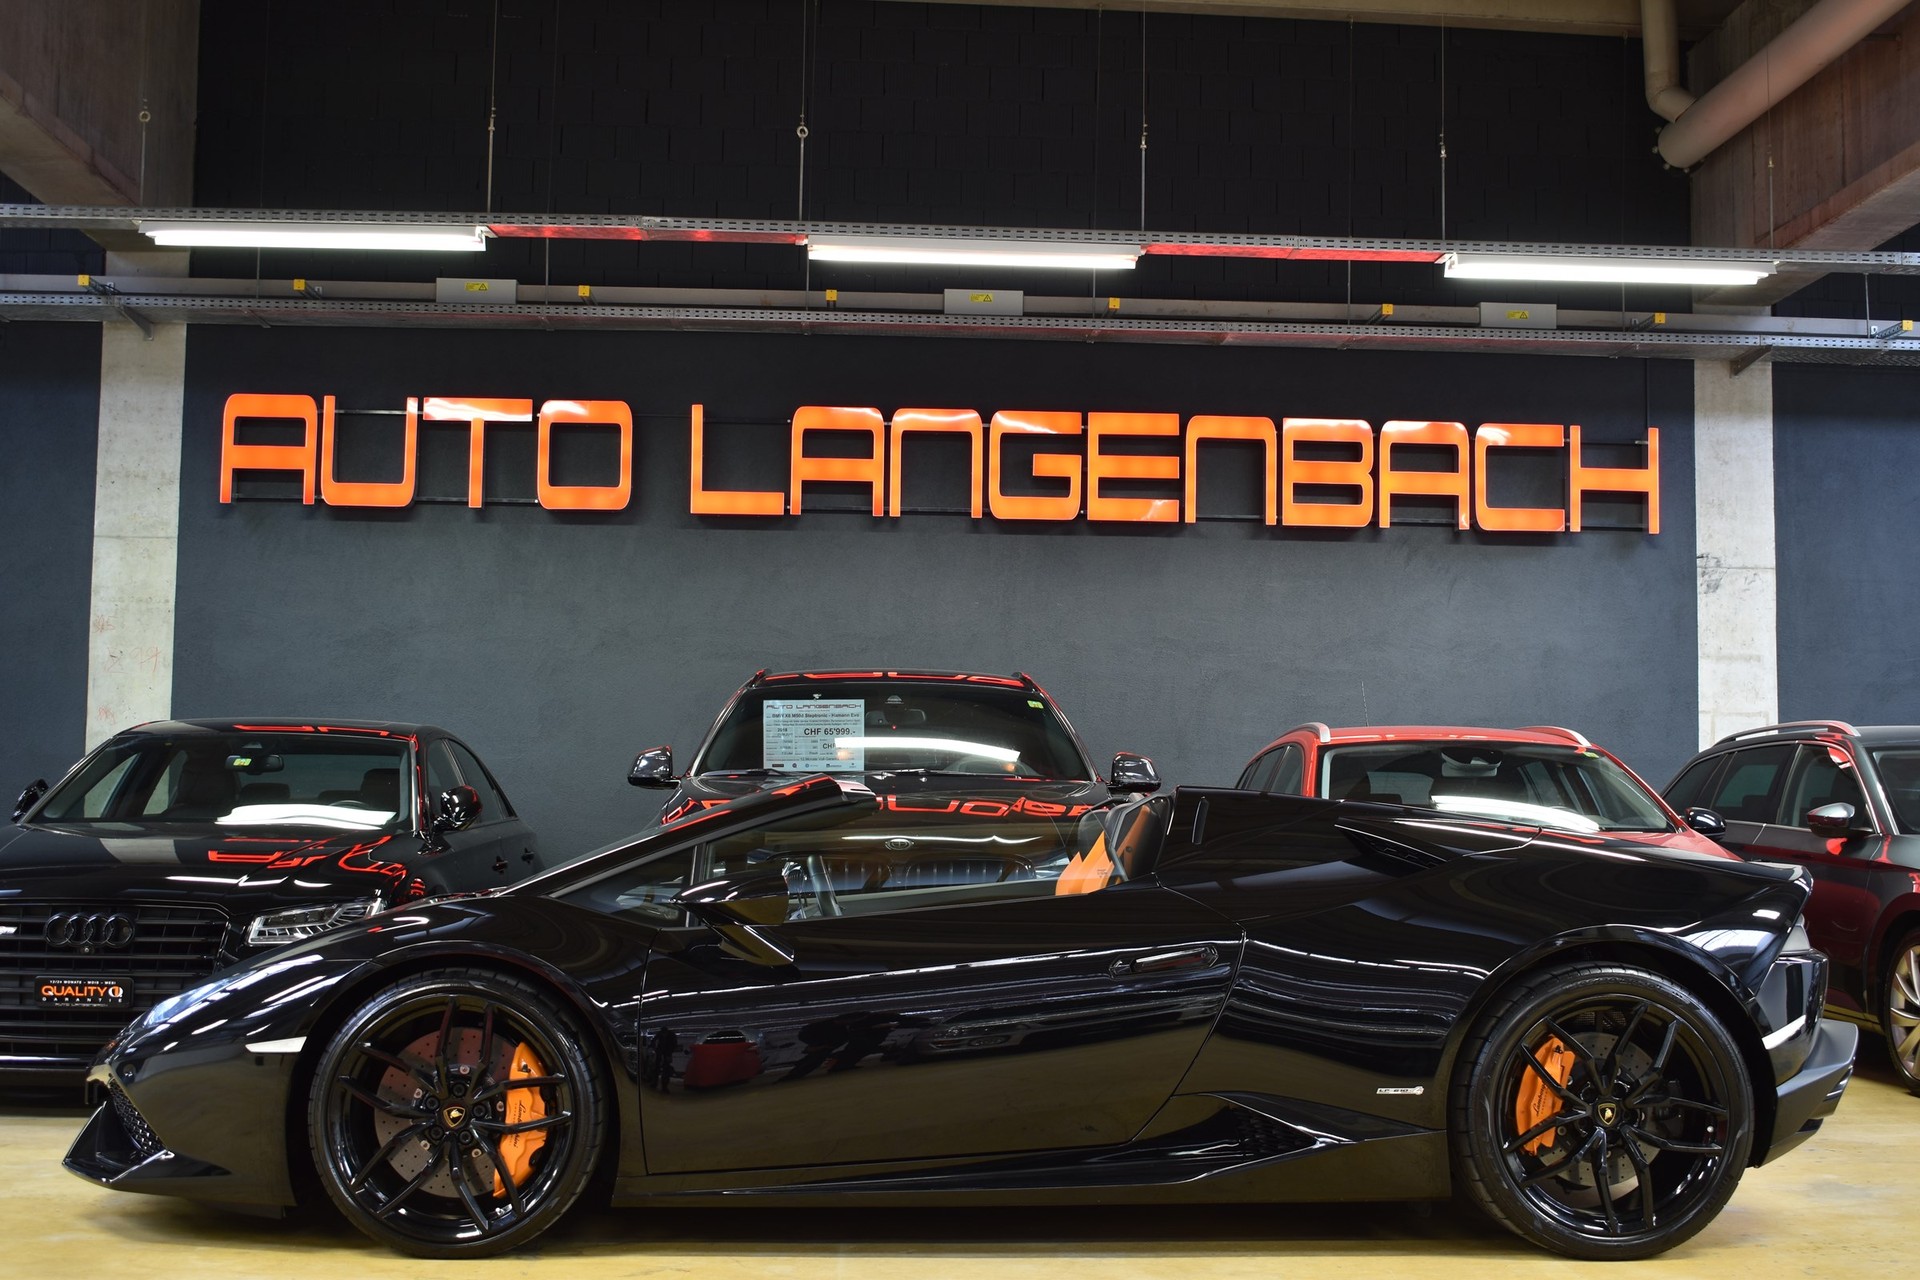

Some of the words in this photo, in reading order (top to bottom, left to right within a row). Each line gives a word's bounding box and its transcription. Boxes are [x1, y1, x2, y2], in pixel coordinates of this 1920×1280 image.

[219, 393, 633, 510] AUTO
[690, 403, 1660, 535] LANGENBACH
[41, 985, 107, 997] QUALITY
